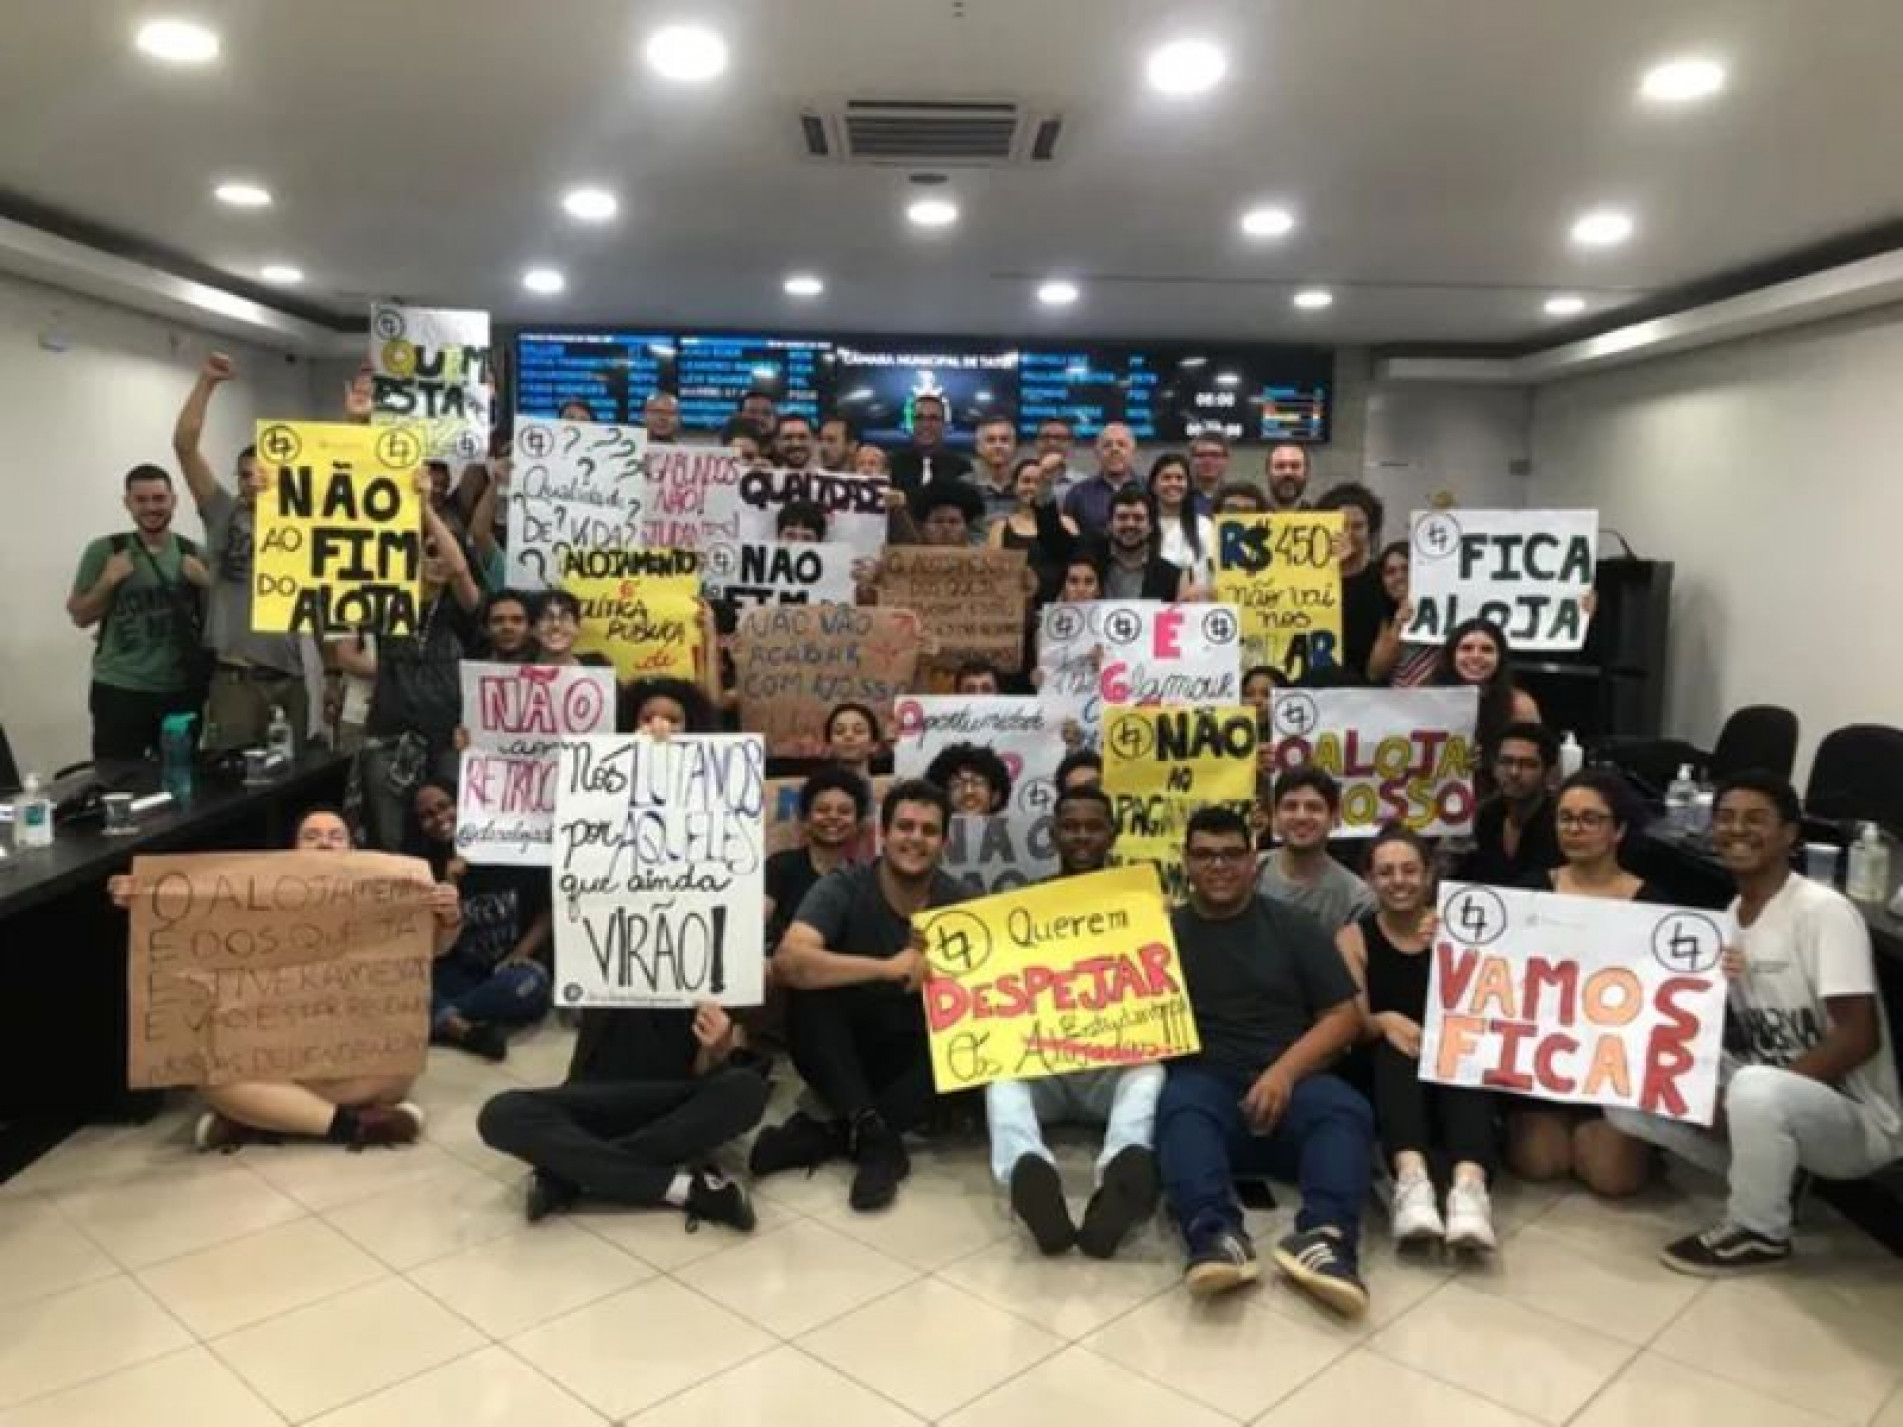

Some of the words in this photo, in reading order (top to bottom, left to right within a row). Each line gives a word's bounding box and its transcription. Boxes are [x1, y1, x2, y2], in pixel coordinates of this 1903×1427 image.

[278, 460, 402, 523] NÃO
[261, 526, 302, 552] AO
[311, 528, 418, 581] FIM
[1274, 523, 1333, 569] 450
[1460, 533, 1592, 583] FICA
[257, 572, 297, 597] DO
[477, 667, 604, 734] NÃO
[1156, 706, 1257, 762] NÃO
[560, 818, 622, 869] por
[627, 864, 732, 893] ainda
[582, 898, 729, 994] VIRÃO!
[1007, 905, 1129, 948] Querem
[926, 941, 1181, 1034] DESPEJAR
[1436, 942, 1713, 1040] VAMOS
[1432, 1014, 1695, 1116] FICAR
